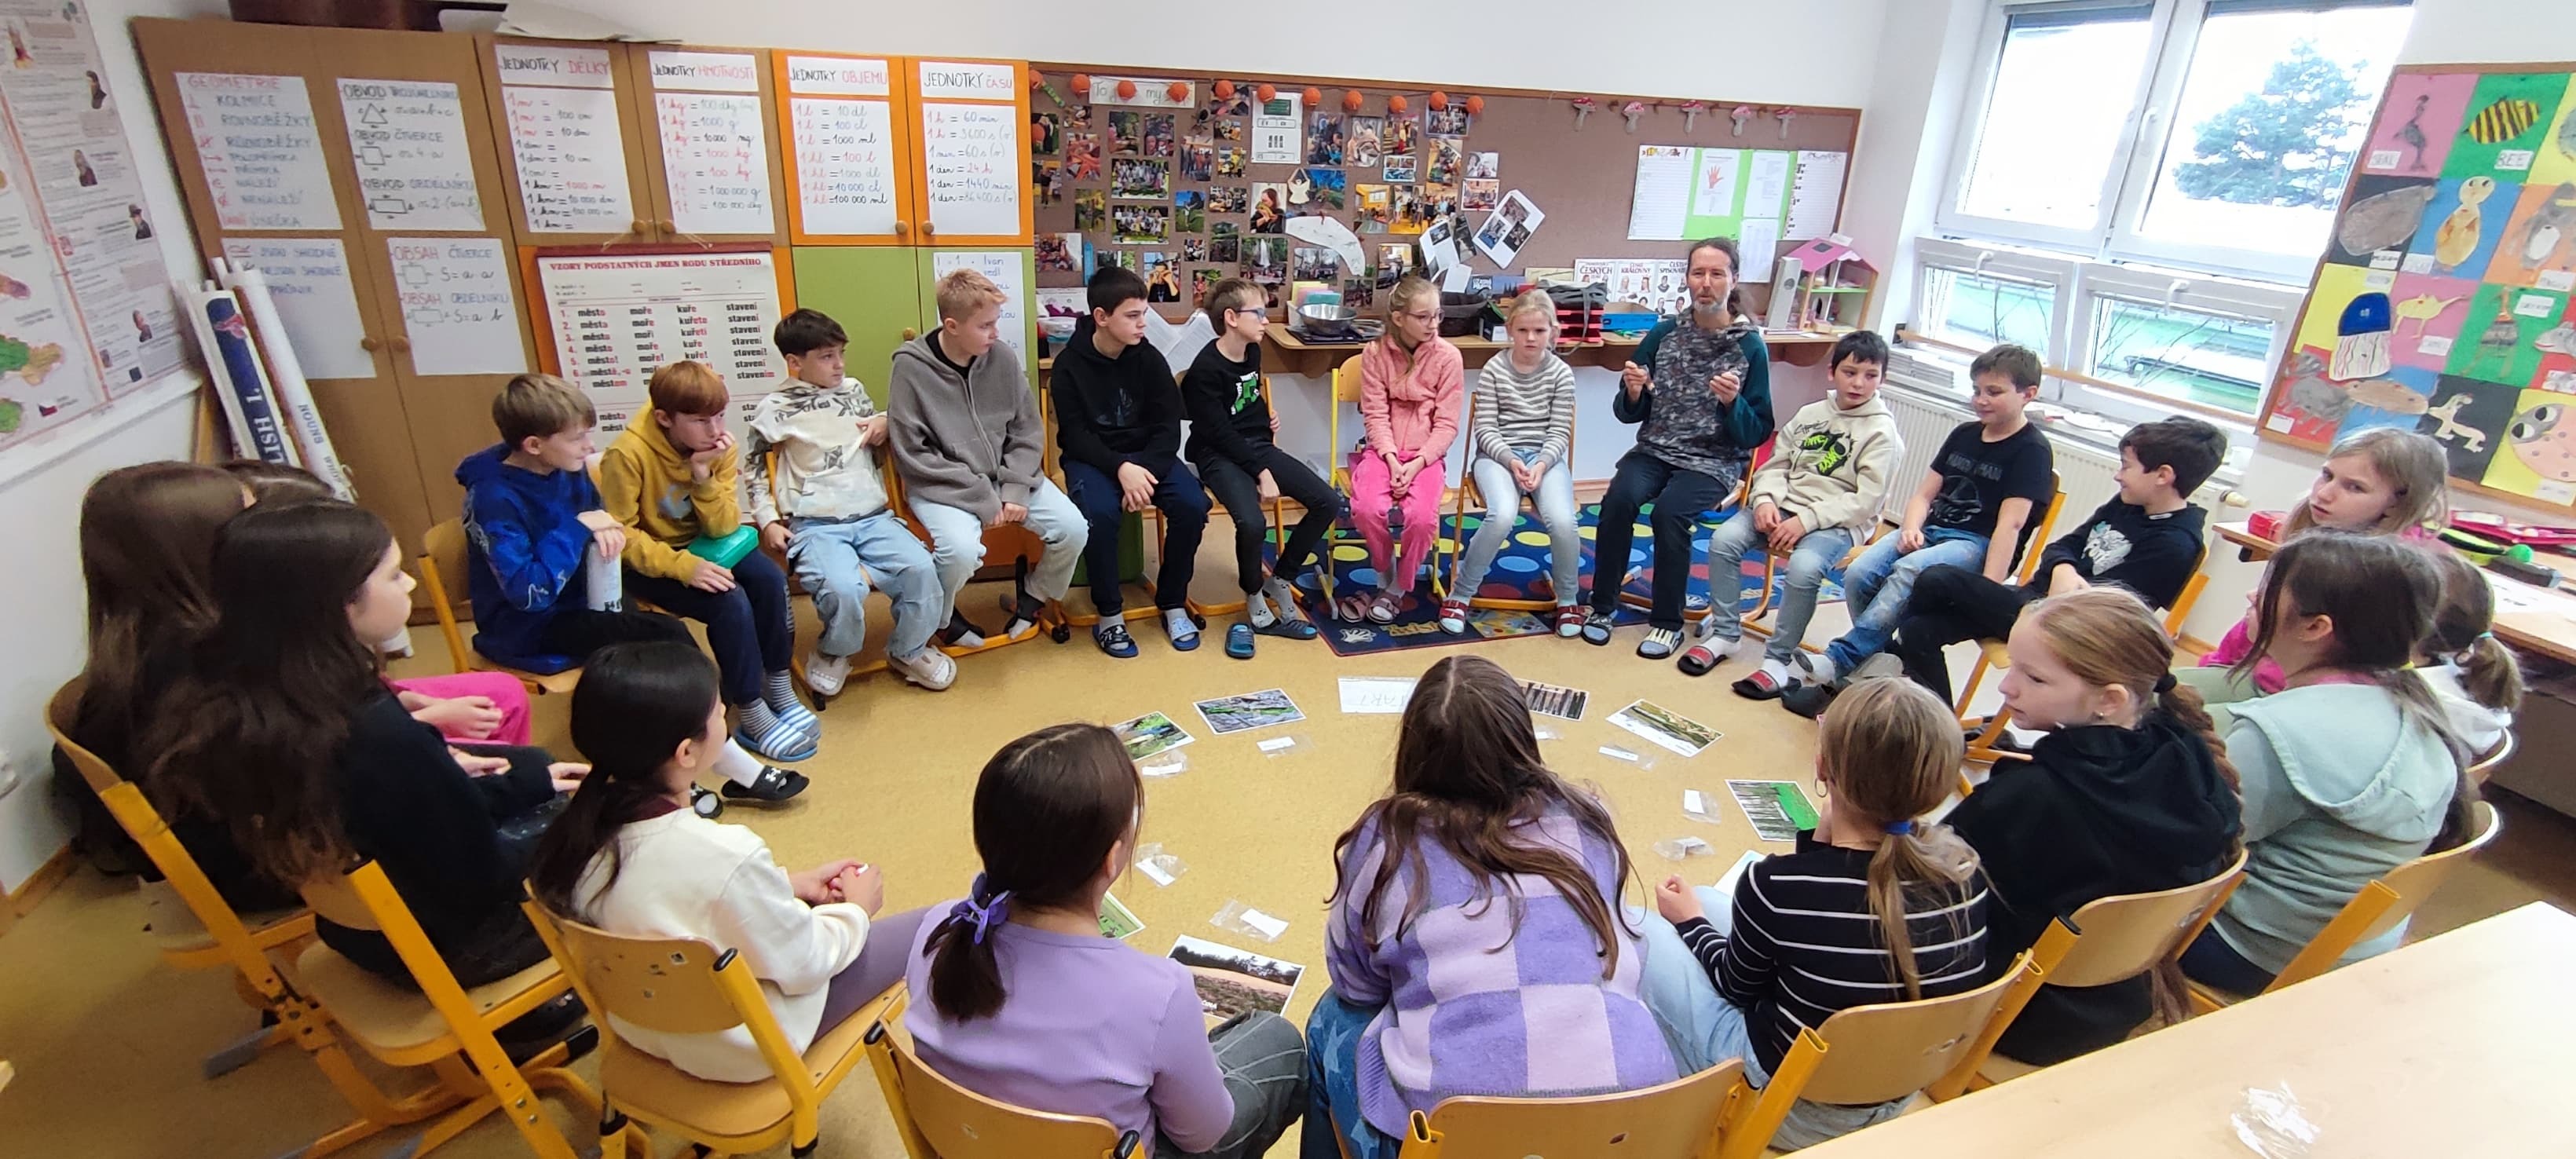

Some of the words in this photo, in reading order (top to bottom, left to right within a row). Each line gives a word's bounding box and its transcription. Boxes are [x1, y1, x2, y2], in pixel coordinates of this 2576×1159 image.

[500, 56, 559, 73] JEDNOTKY
[567, 56, 609, 75] DÉLKY
[653, 64, 696, 77] JEDNOTKY
[698, 64, 754, 79] HMOTNOSTI
[188, 75, 281, 89] GEOMETRIE
[790, 68, 836, 82] JEDNOTKY
[842, 70, 887, 85] OBJEMU
[924, 71, 984, 88] JEDNOTKY
[986, 75, 1012, 89] ČASU
[342, 85, 386, 98] OBVOD
[1092, 81, 1107, 97] To
[1146, 89, 1162, 105] my
[964, 111, 977, 122] 60
[832, 133, 854, 144] 1000
[965, 144, 979, 157] 60
[936, 165, 954, 174] den
[937, 179, 954, 188] den
[966, 177, 990, 189] 1440
[869, 192, 888, 204] ml
[393, 246, 440, 261] OBSAH
[984, 254, 1004, 265] Ivan
[584, 259, 653, 270] PODSTATNÝCH
[682, 259, 707, 268] RODU
[709, 258, 761, 267] STŘEDNÍHO
[578, 308, 606, 316] město
[629, 306, 653, 315] moře
[676, 305, 697, 313] kuře
[726, 302, 757, 312] stavení
[631, 318, 654, 327] moře
[679, 316, 708, 325] kuřete
[728, 313, 759, 323] stavení
[634, 330, 654, 339] moři
[681, 327, 707, 336] kuřeti
[730, 325, 761, 335] stavení
[585, 344, 613, 353] město
[636, 342, 659, 351] moře
[682, 339, 703, 348] kuře
[731, 337, 763, 346] stavení
[639, 353, 664, 362] moře!
[734, 348, 768, 357] stavení!
[735, 359, 766, 367] stavení
[737, 370, 775, 379] stavením
[254, 416, 284, 464] LISH
